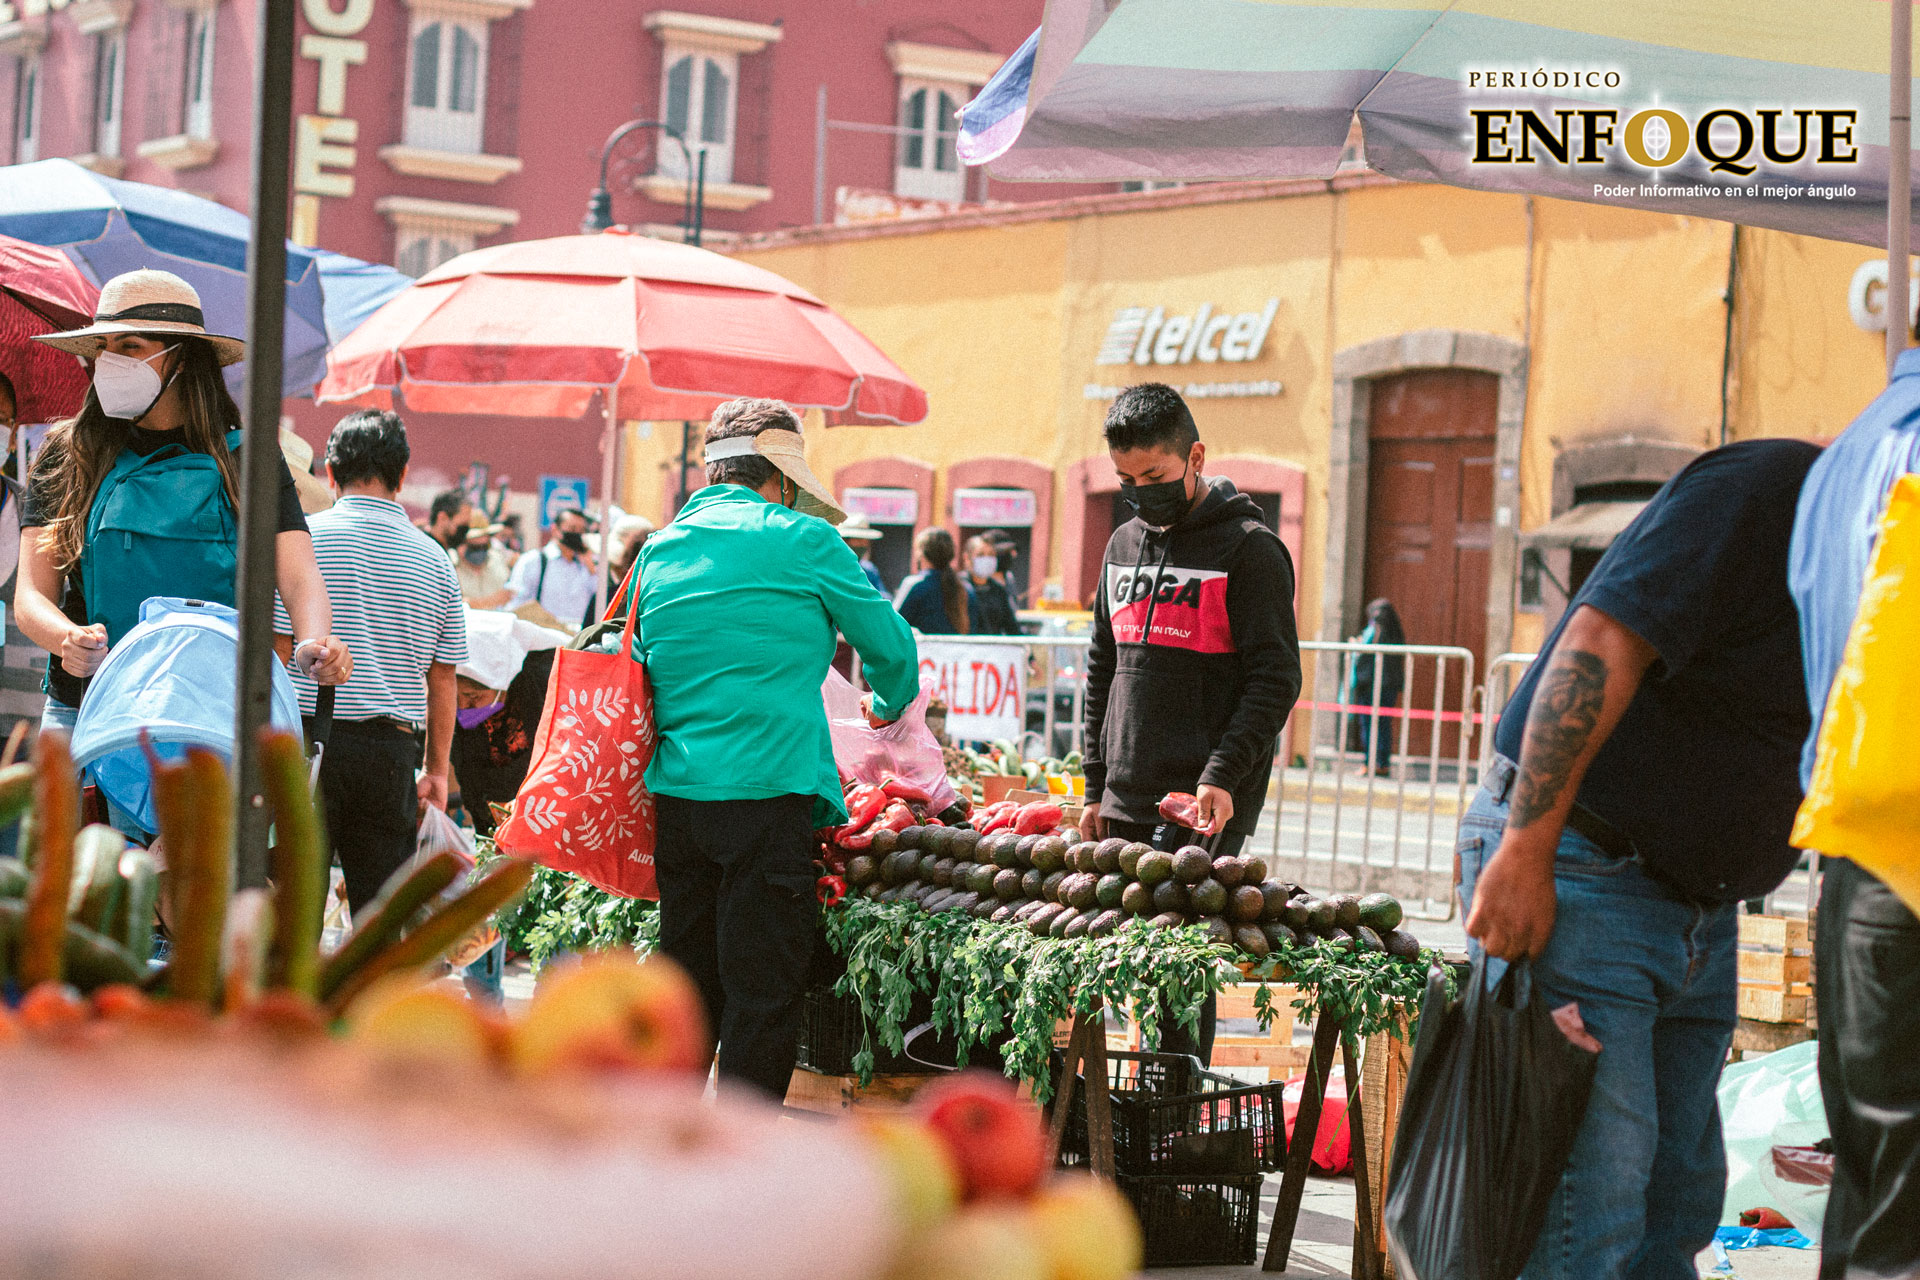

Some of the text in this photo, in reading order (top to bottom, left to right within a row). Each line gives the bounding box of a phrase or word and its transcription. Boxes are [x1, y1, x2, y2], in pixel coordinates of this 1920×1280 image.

[1133, 297, 1280, 365] telcel
[1114, 573, 1202, 609] GOGA
[1164, 626, 1191, 638] ITALY
